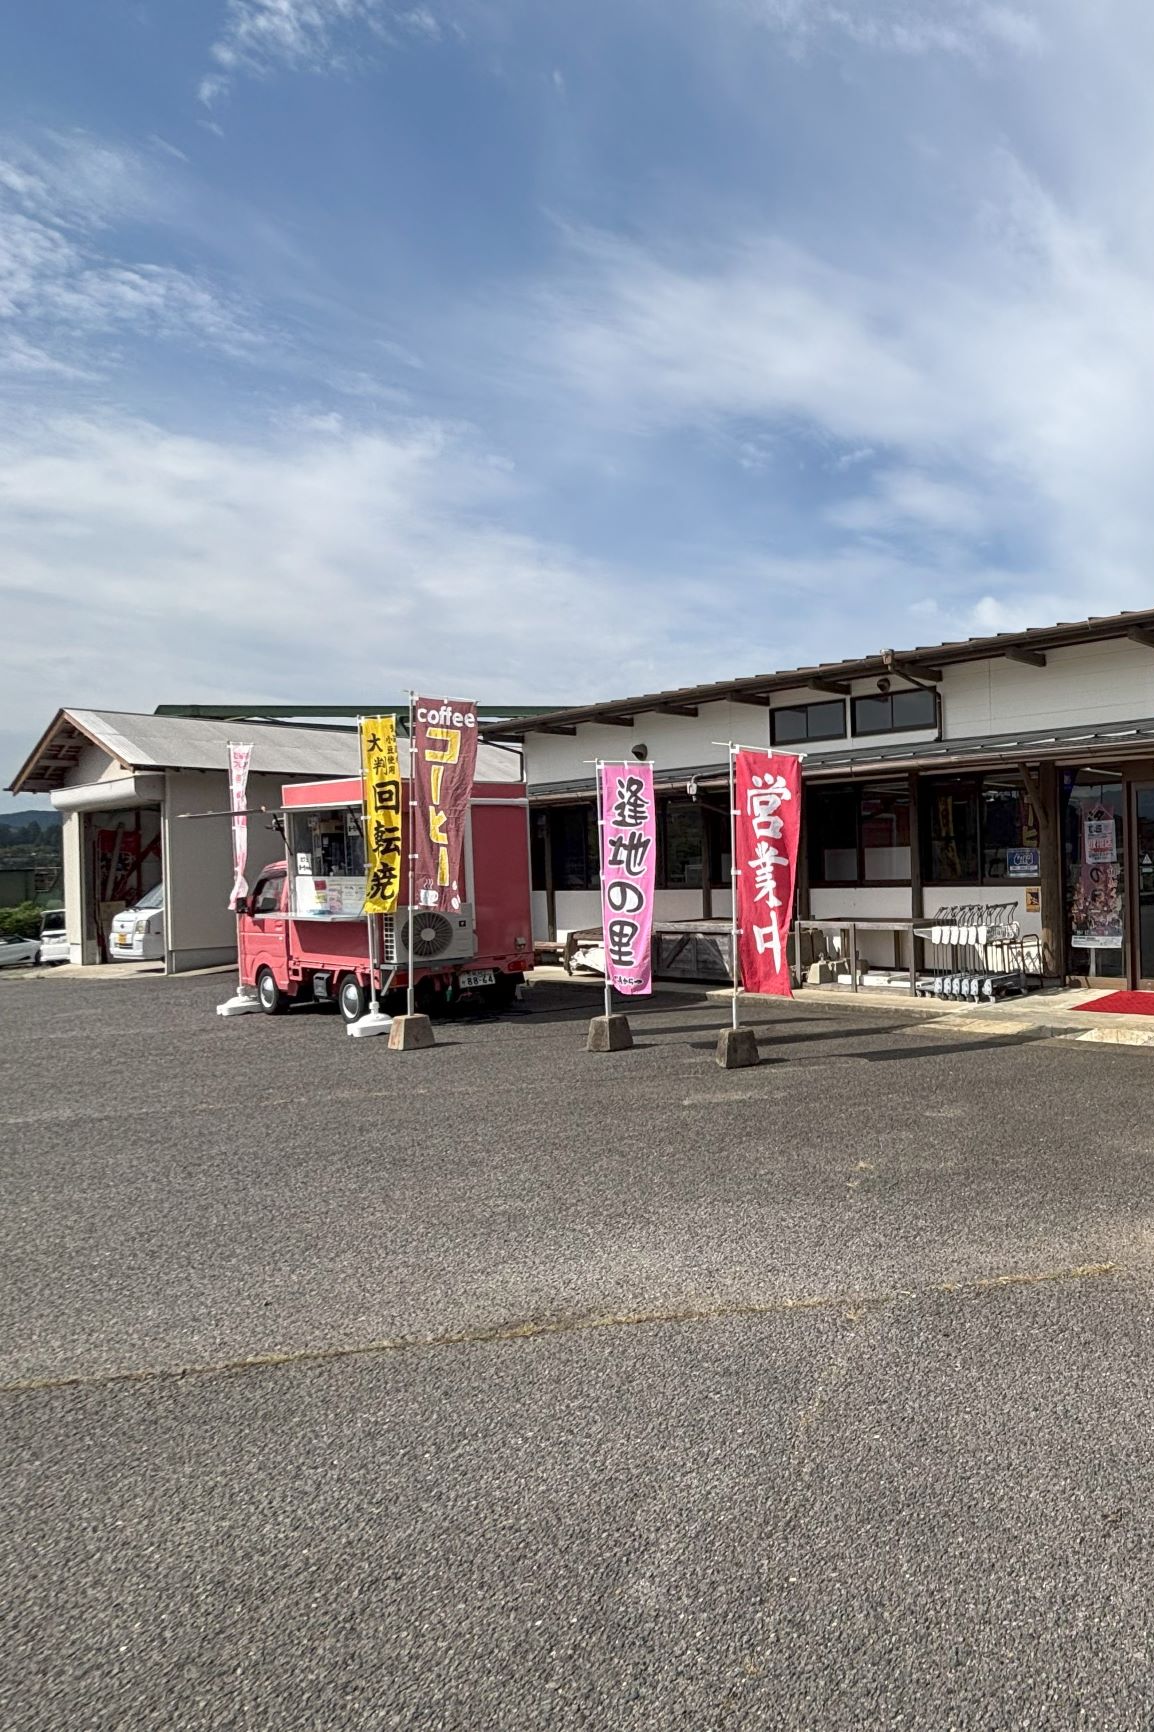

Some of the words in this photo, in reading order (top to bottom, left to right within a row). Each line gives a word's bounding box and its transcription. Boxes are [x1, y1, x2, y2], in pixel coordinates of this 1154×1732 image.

[417, 706, 475, 727] coffee
[425, 727, 461, 887] コーヒー
[608, 777, 651, 967] 逢地の里
[747, 773, 791, 975] 営業中
